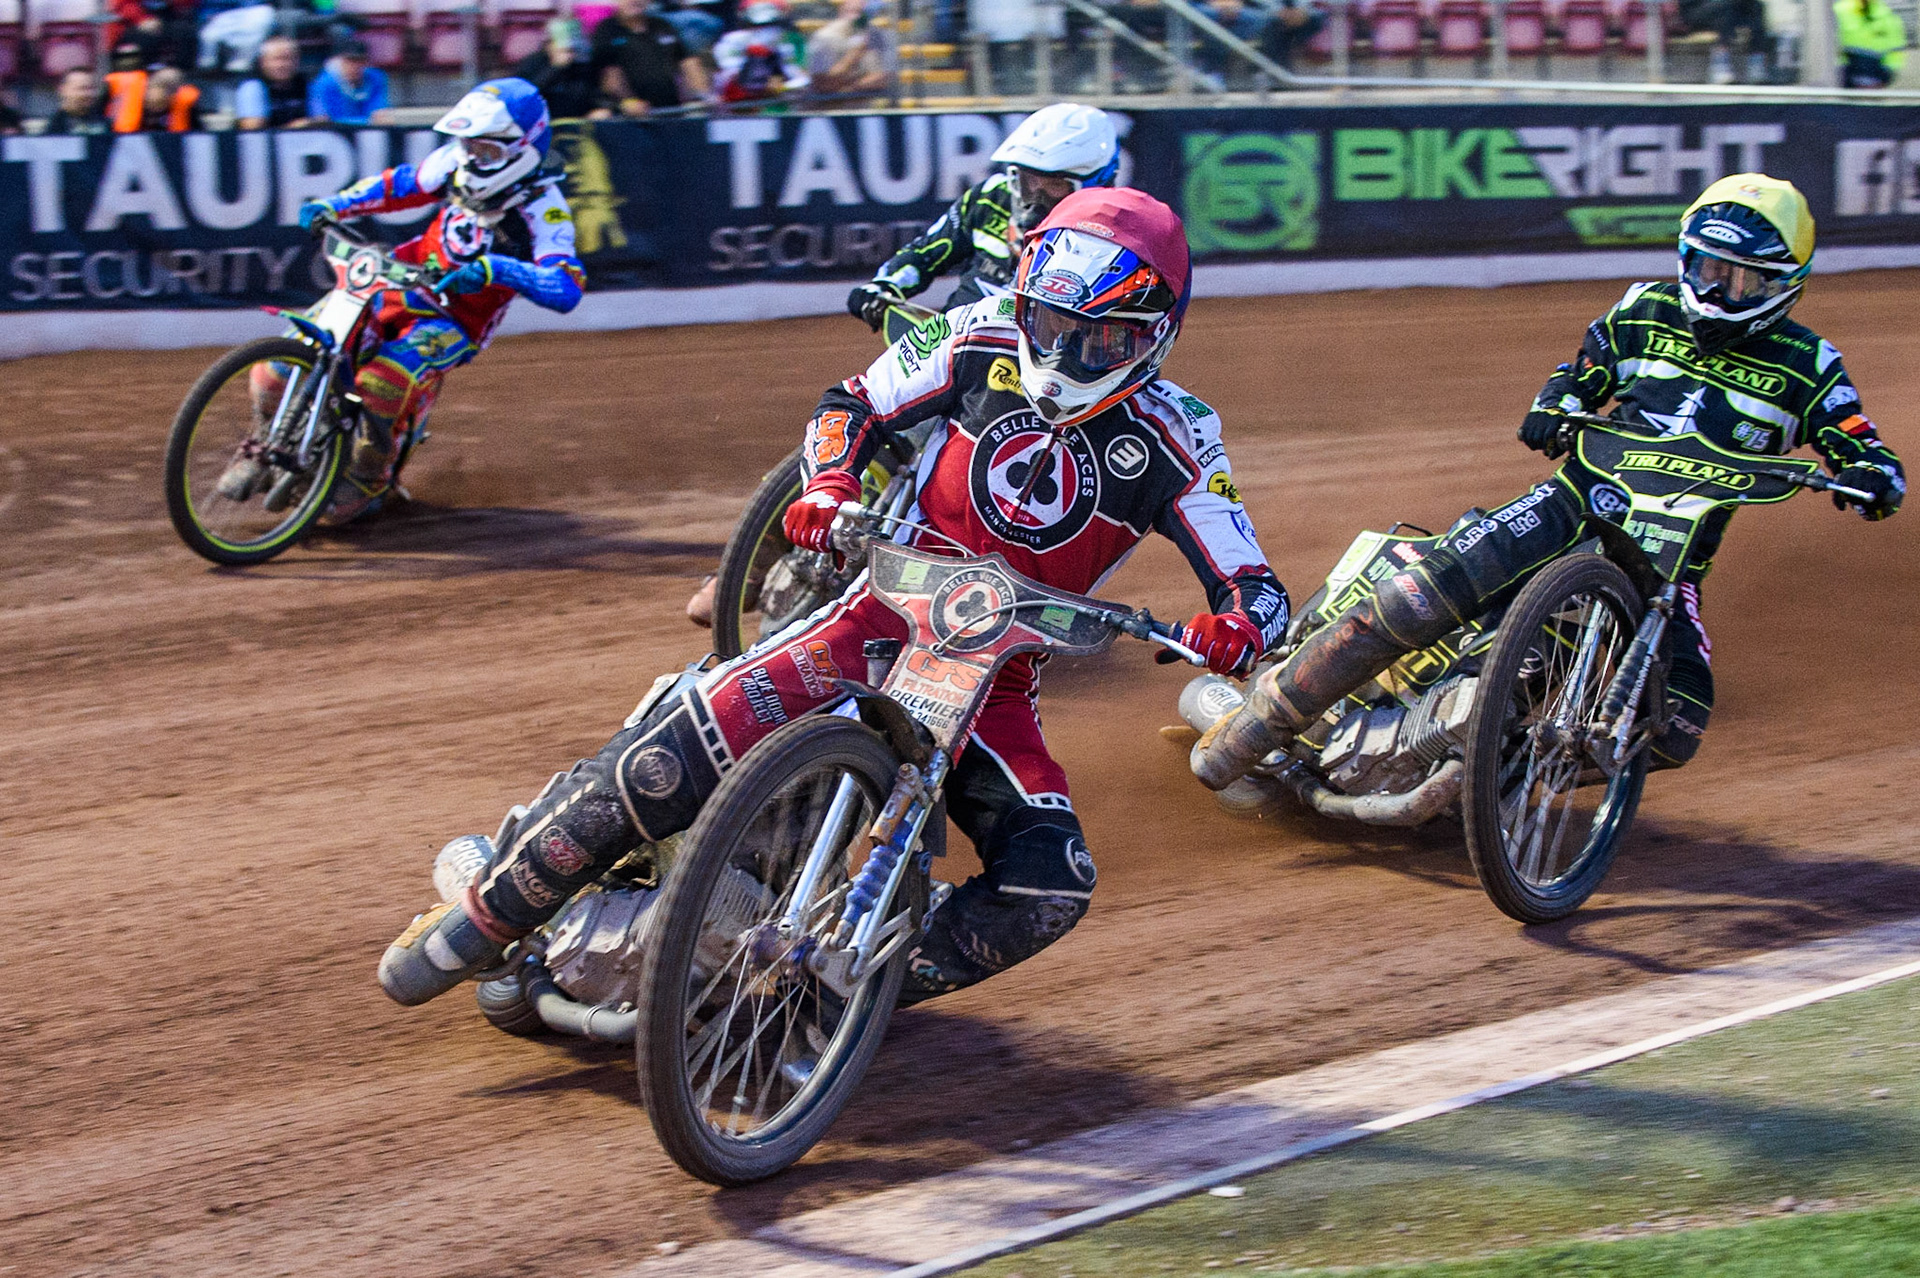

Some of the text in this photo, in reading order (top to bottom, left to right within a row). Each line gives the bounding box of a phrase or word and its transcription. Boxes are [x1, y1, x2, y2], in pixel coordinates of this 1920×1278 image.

[706, 112, 1135, 208] TAUR
[1333, 124, 1786, 201] BIKERIGHT
[3, 129, 440, 232] TAURU
[9, 245, 303, 300] SECURITY
[1037, 276, 1081, 295] STS
[992, 362, 1021, 389] Rent
[1040, 381, 1059, 395] STS
[1733, 420, 1775, 450] #15
[990, 415, 1041, 443] BELLE
[1077, 452, 1094, 498] ACES
[1626, 454, 1747, 486] TRU PLANT
[943, 572, 974, 594] BELLE
[979, 572, 999, 586] VUE
[787, 645, 825, 698] FILTRATION
[738, 677, 773, 724] PROJECT
[751, 666, 790, 725] BLUE DOOR
[889, 689, 966, 721] PREMIER
[901, 677, 966, 706] FILTRATION
